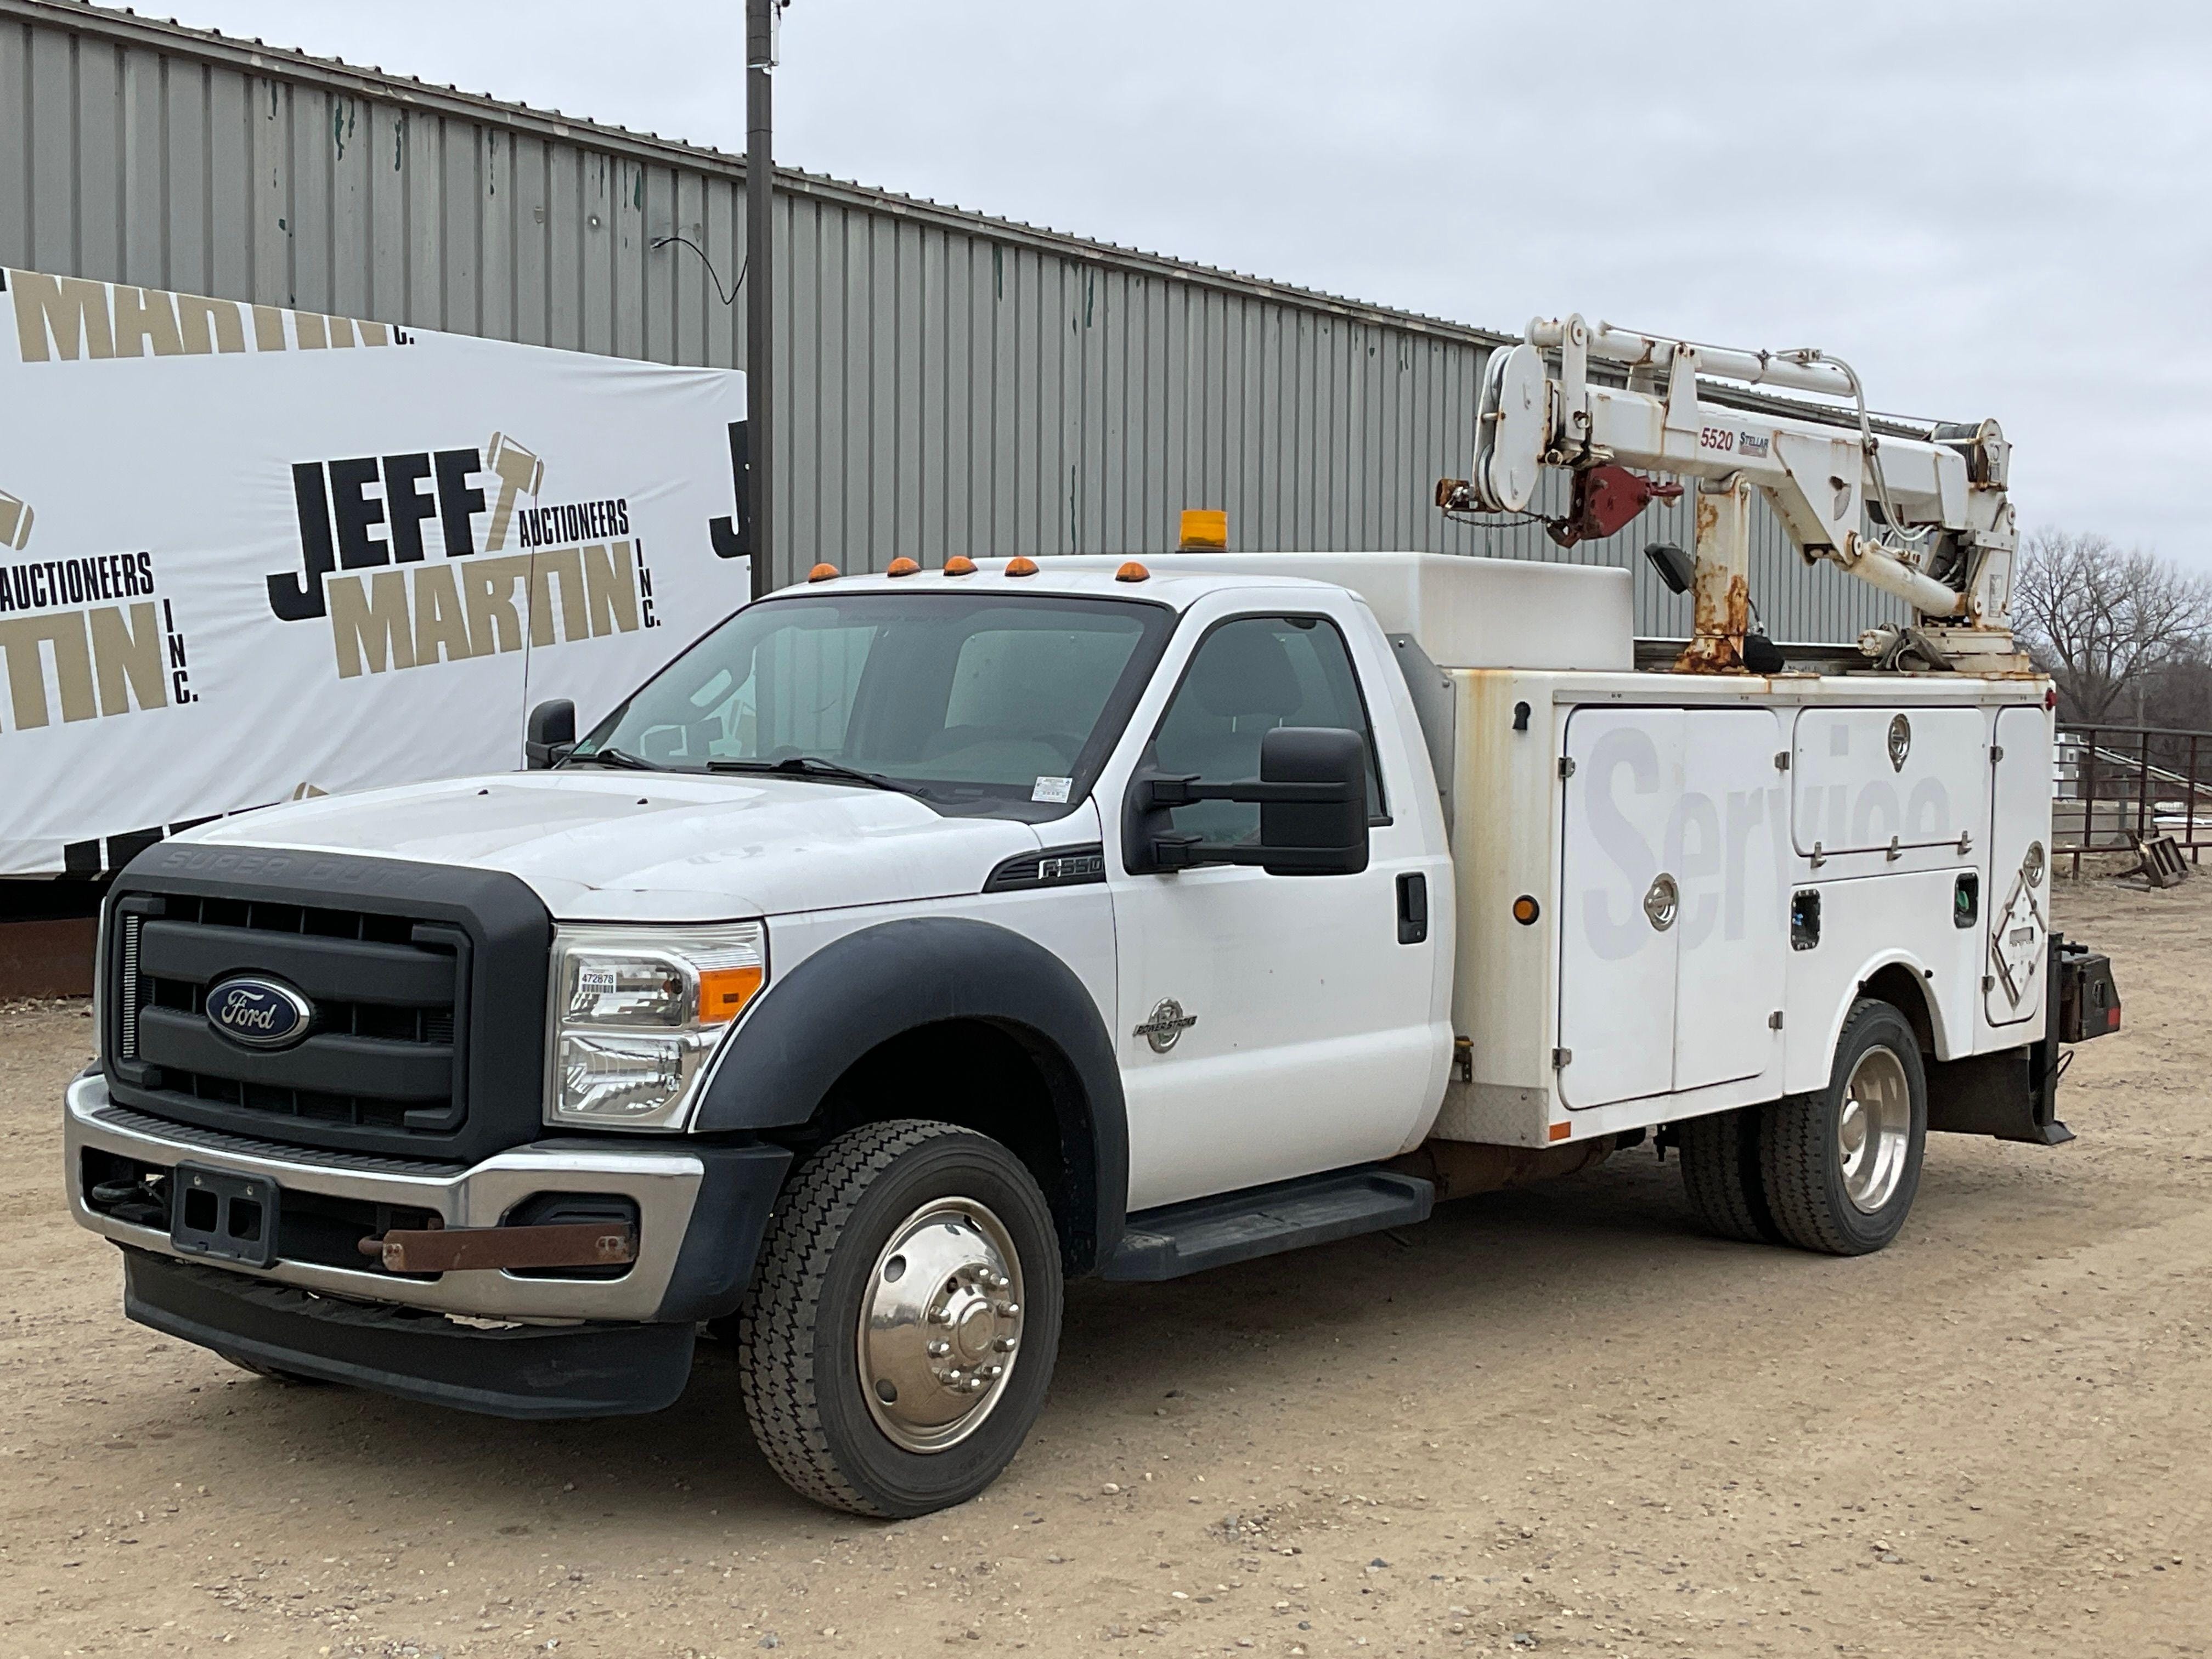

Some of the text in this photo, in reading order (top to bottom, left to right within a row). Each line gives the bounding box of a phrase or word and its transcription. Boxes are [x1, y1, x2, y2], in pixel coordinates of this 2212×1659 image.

[10, 269, 388, 362] MAR
[1701, 427, 1733, 450] 5520
[267, 448, 487, 621] JEFF
[518, 498, 629, 548] AUCTIONEERS
[0, 552, 154, 612] AUCTIONEERS
[327, 540, 640, 679] MARTIN
[635, 538, 661, 628] INC.
[0, 602, 168, 733] TIN
[163, 599, 198, 704] INC.
[162, 850, 293, 877] SUPER
[222, 990, 276, 1029] Ford
[1136, 1022, 1166, 1034] POWER
